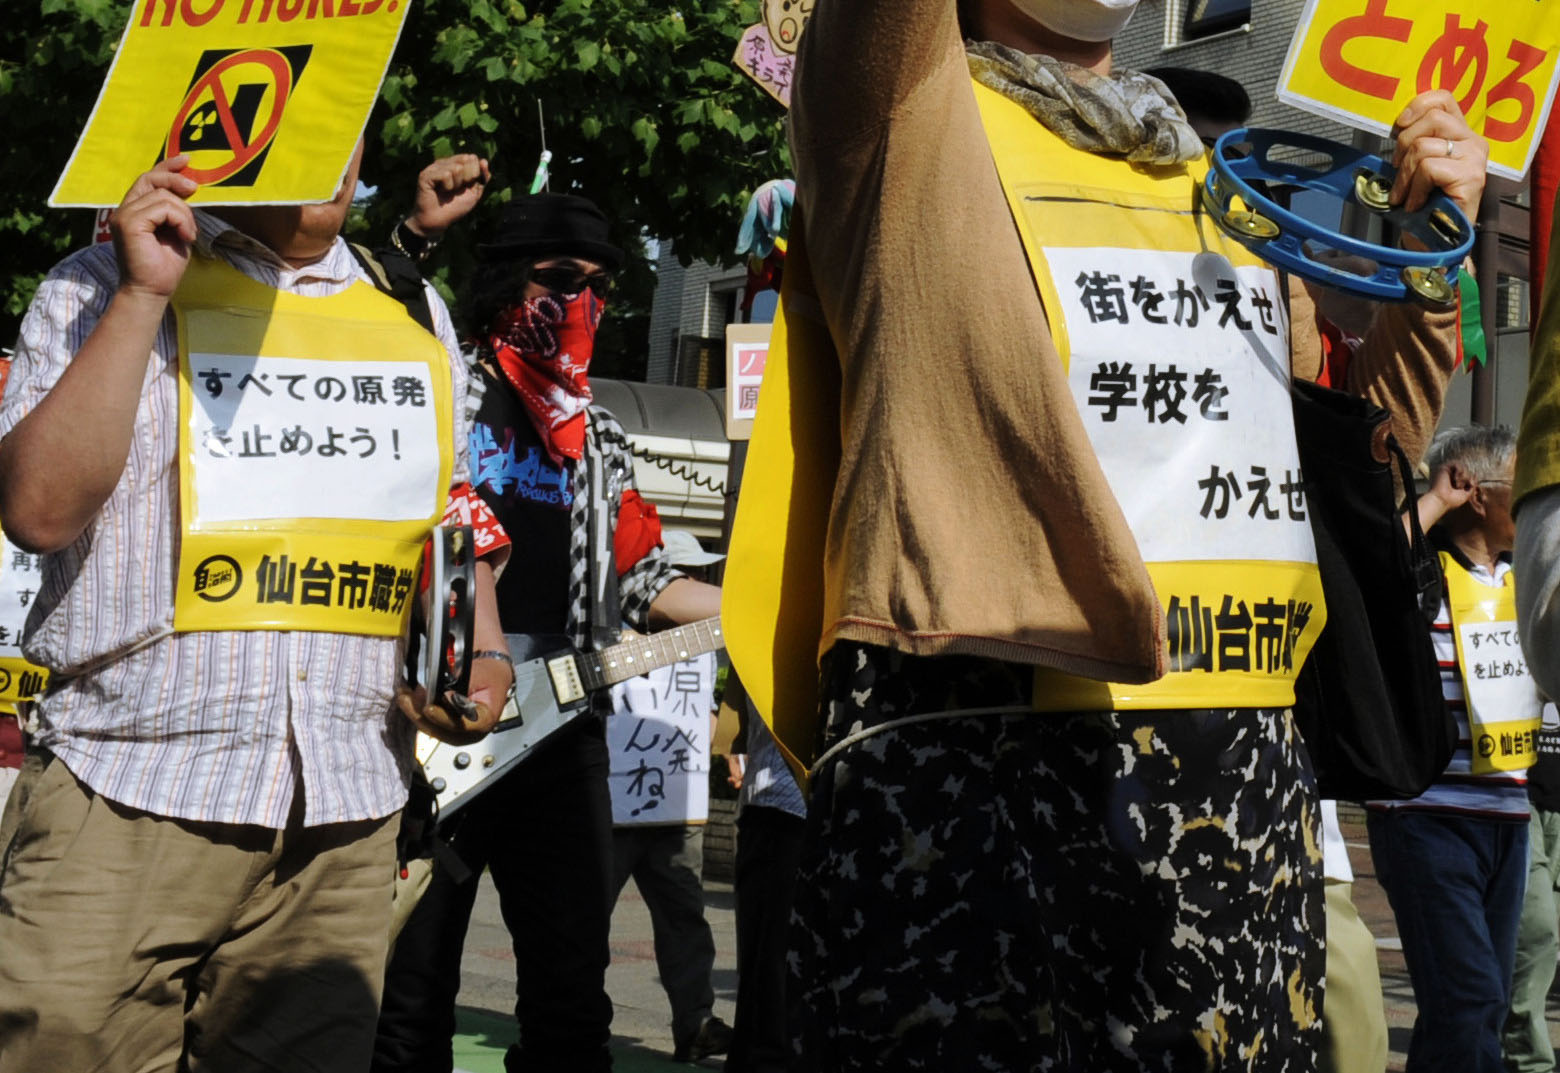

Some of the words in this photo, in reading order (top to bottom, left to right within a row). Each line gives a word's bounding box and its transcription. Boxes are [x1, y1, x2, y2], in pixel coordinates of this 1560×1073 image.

[198, 367, 426, 407] すべての原発
[1087, 361, 1230, 425] 学校を
[202, 424, 402, 460] を止めよう！
[1198, 464, 1306, 522] かえせ
[1474, 660, 1531, 679] を止めよ
